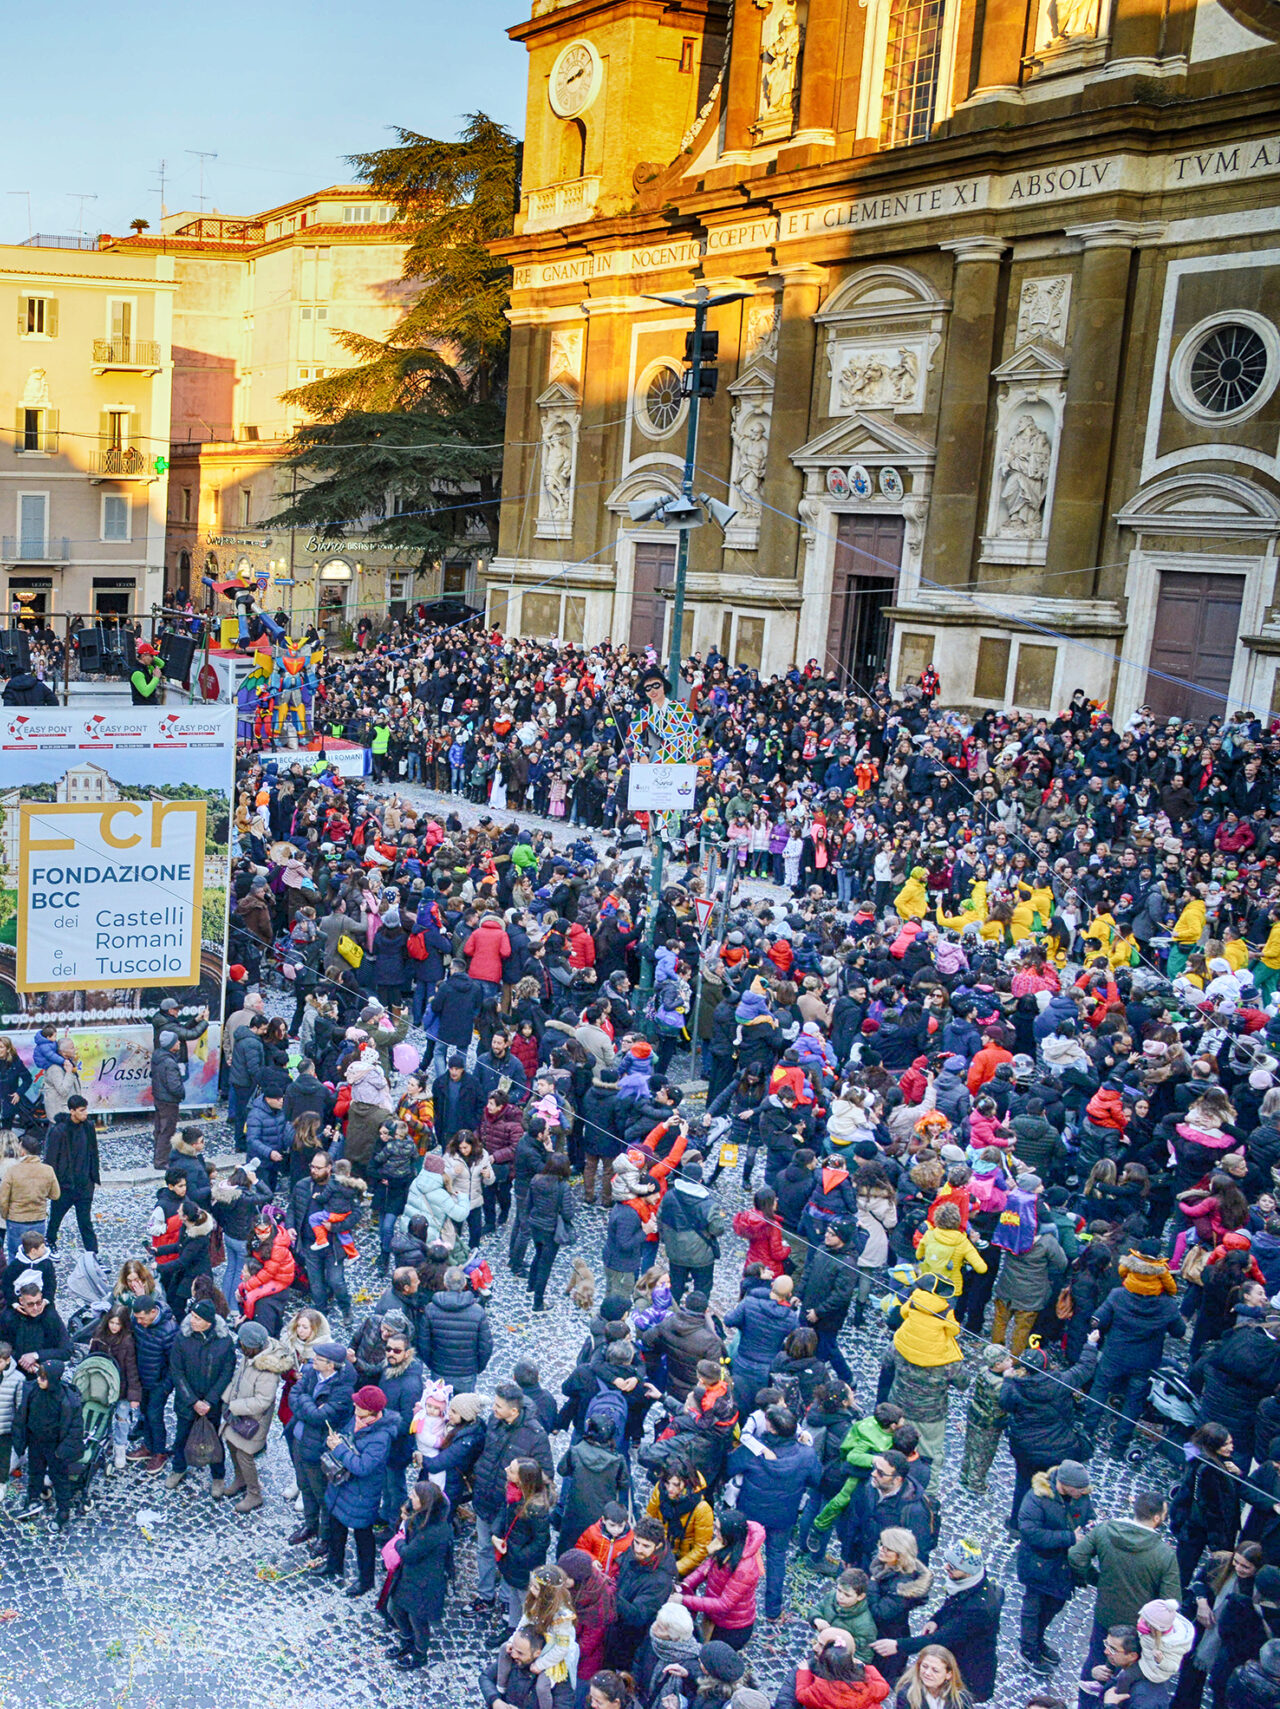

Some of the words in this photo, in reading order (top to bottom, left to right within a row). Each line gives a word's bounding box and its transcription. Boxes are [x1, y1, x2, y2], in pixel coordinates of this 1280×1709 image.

[788, 212, 815, 234] ET
[823, 188, 942, 228] CLEMENTE
[952, 182, 979, 206] XI
[1008, 162, 1111, 200] ABSOLV
[1173, 148, 1241, 180] TVM
[23, 725, 46, 733] EASY
[48, 725, 73, 733] PONT
[100, 725, 123, 733] EASY
[124, 725, 148, 733] PONT
[174, 724, 197, 732] EASY
[198, 724, 222, 732] PONT
[335, 753, 363, 761] ROMANI
[32, 864, 191, 886] FONDAZIONE
[32, 890, 80, 910] BCC
[53, 915, 79, 929] dei
[96, 906, 184, 928] Castelli
[96, 928, 183, 950] Romani
[53, 949, 64, 959] e
[52, 962, 77, 977] del
[95, 954, 182, 975] Tuscolo
